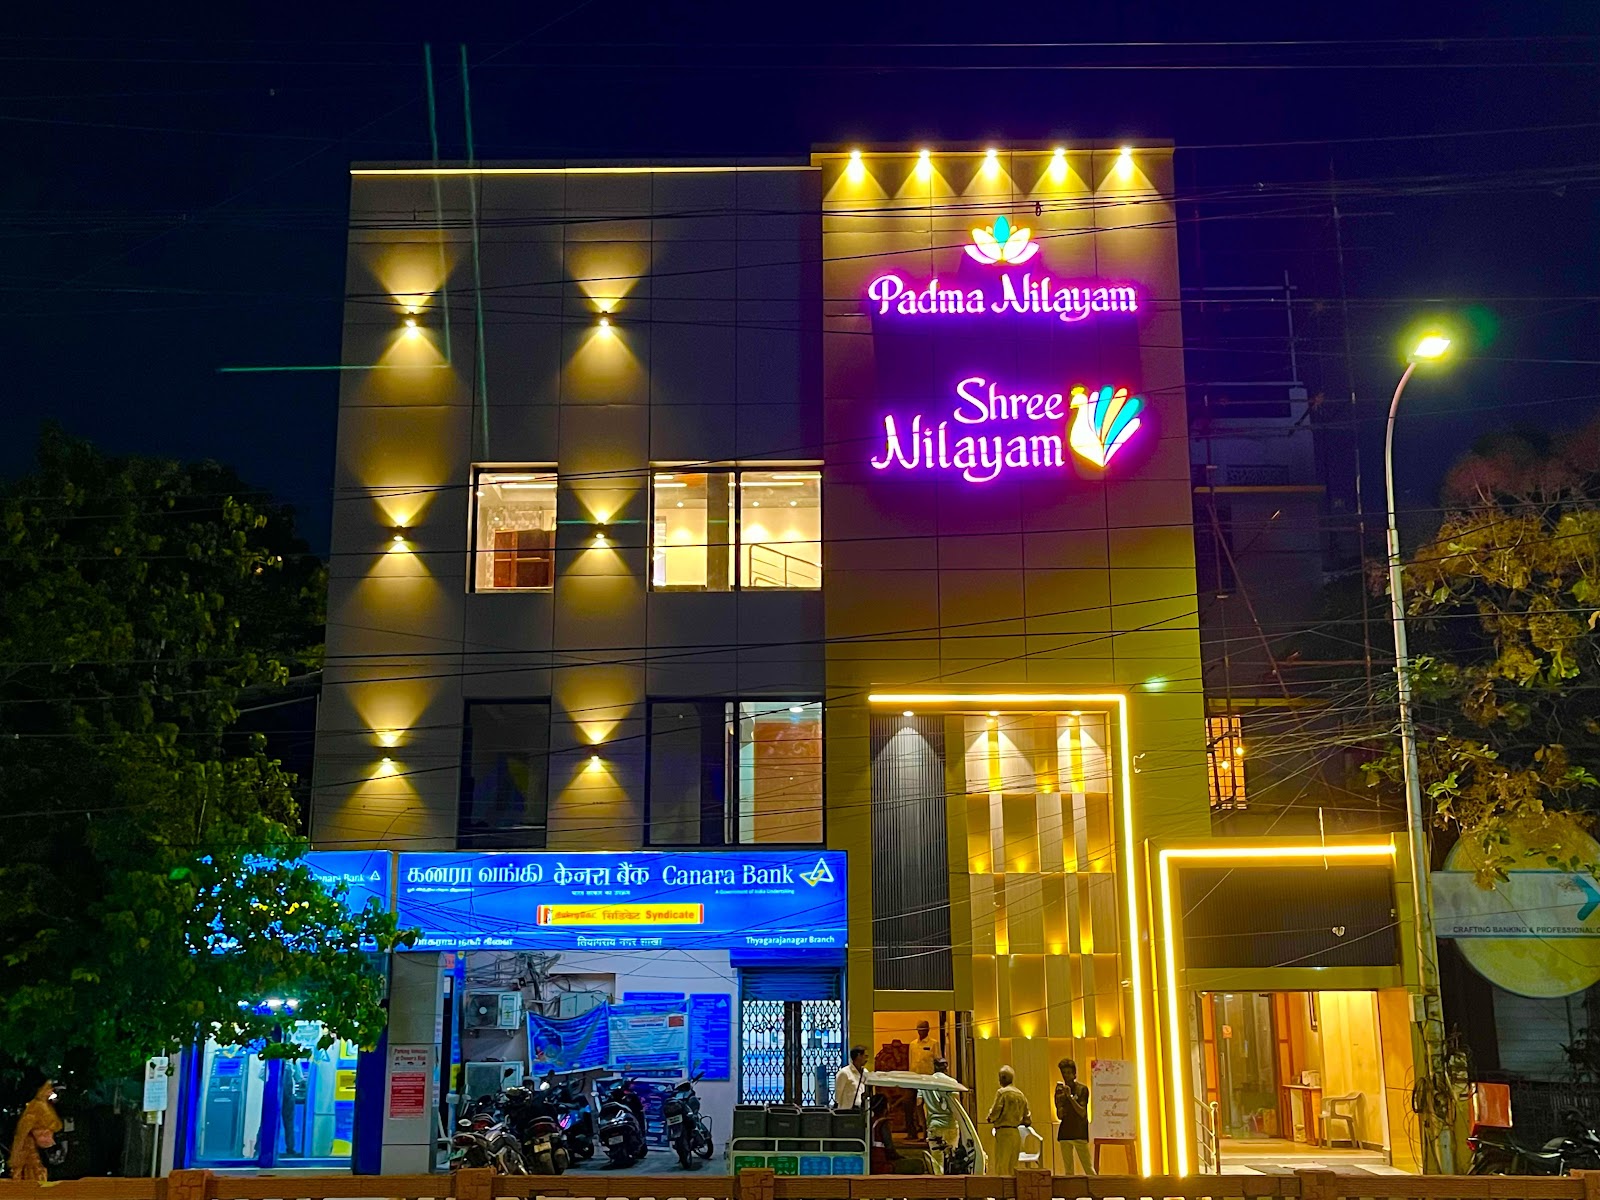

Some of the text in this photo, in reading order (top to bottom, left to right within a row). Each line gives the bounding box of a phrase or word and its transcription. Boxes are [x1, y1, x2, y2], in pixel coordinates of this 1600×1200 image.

[868, 273, 1138, 322] Padma Nilayam
[953, 376, 1065, 424] Shree
[870, 414, 1065, 483] Nilayam
[407, 863, 543, 886] கனரா வங்கி
[554, 861, 650, 886] केनरा बैंक
[663, 864, 794, 885] Canara Bank
[645, 910, 695, 921] Syndicate
[746, 936, 808, 946] Thyagarajanagar
[1536, 926, 1592, 934] PROFESSIONAL
